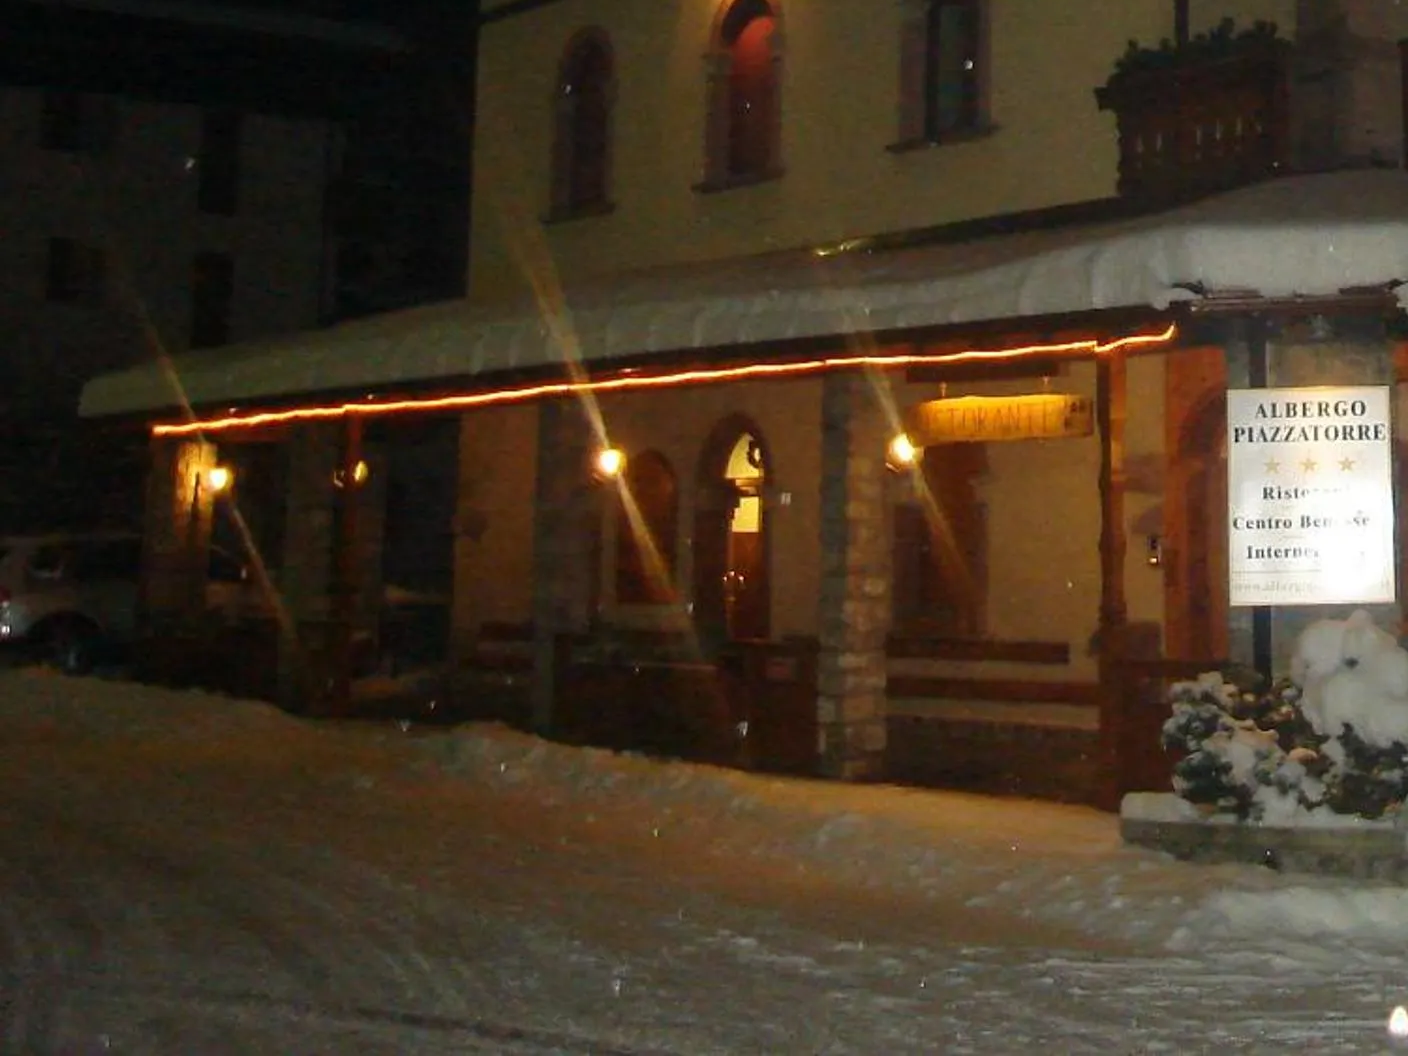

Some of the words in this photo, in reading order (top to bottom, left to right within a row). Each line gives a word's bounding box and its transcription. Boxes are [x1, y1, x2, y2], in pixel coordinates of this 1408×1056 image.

[916, 401, 1061, 434] STORANTE
[1255, 400, 1367, 419] ALBERGO
[1233, 423, 1386, 443] PIAZZATORRE
[1233, 515, 1293, 530] Centro
